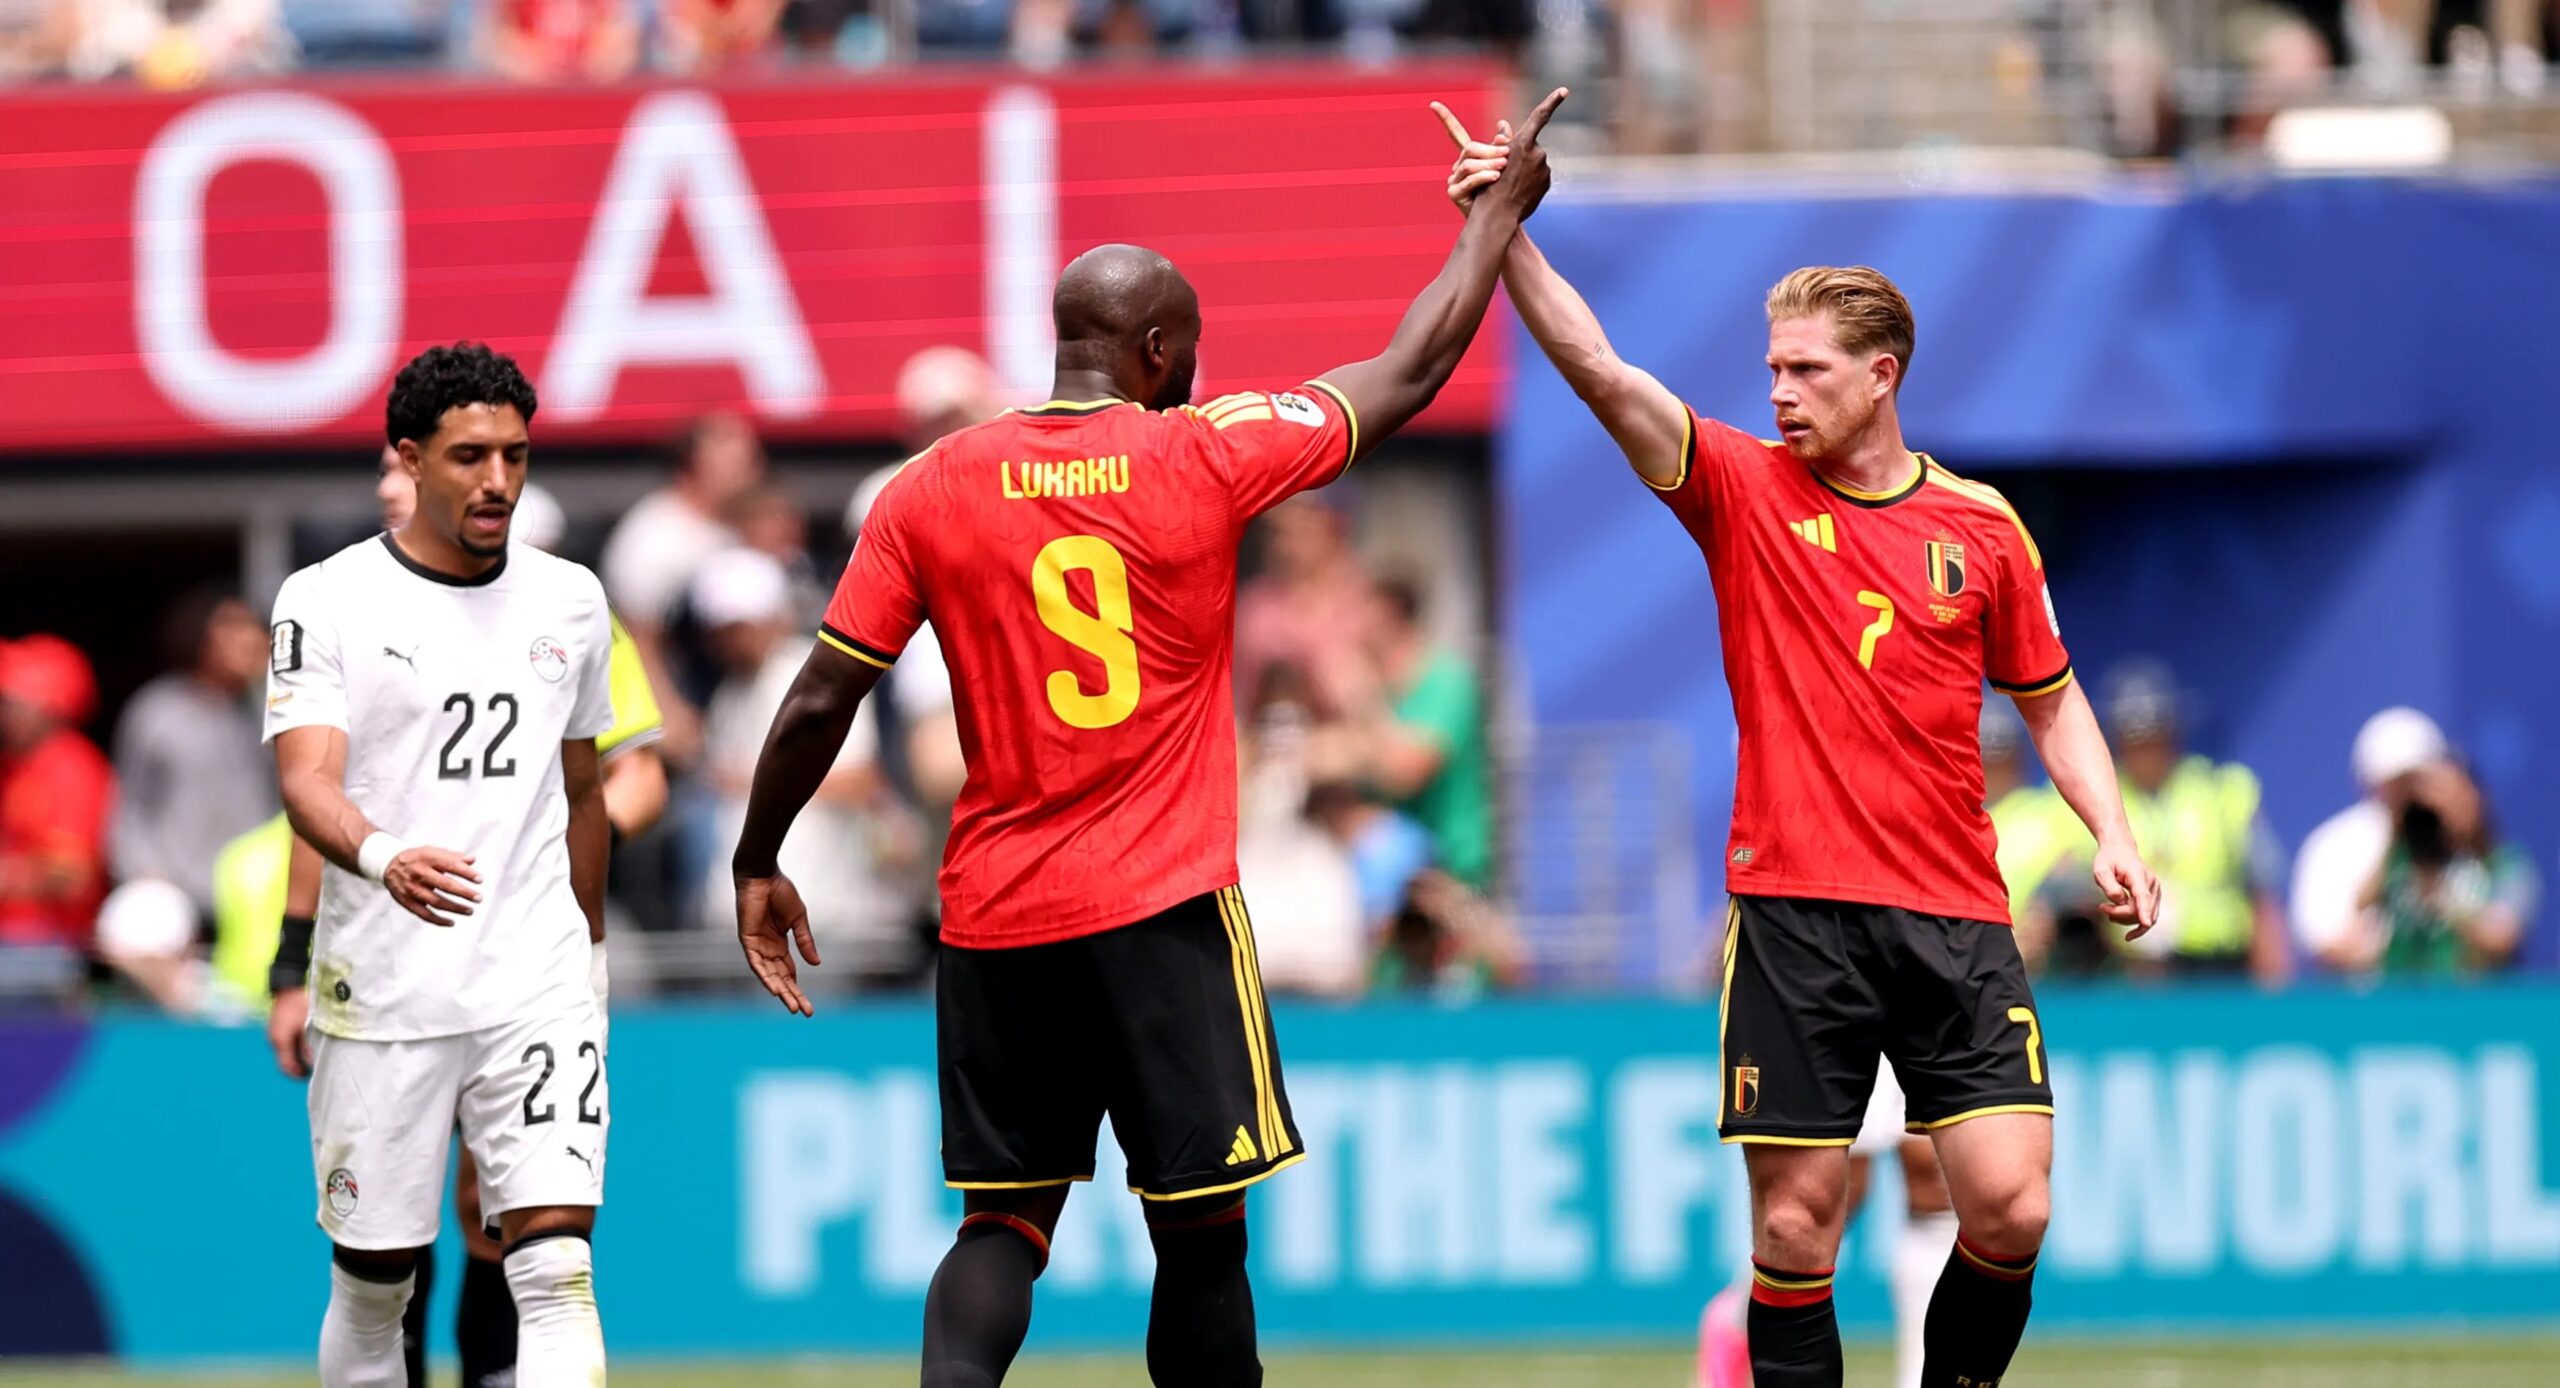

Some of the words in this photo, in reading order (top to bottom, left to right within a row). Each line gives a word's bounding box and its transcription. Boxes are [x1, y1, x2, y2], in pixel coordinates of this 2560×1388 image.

[1000, 454, 1131, 499] LUKAKU
[1031, 535, 1141, 729] 9
[1857, 589, 1895, 671] 7
[438, 691, 519, 778] 22
[2006, 1006, 2044, 1085] 7
